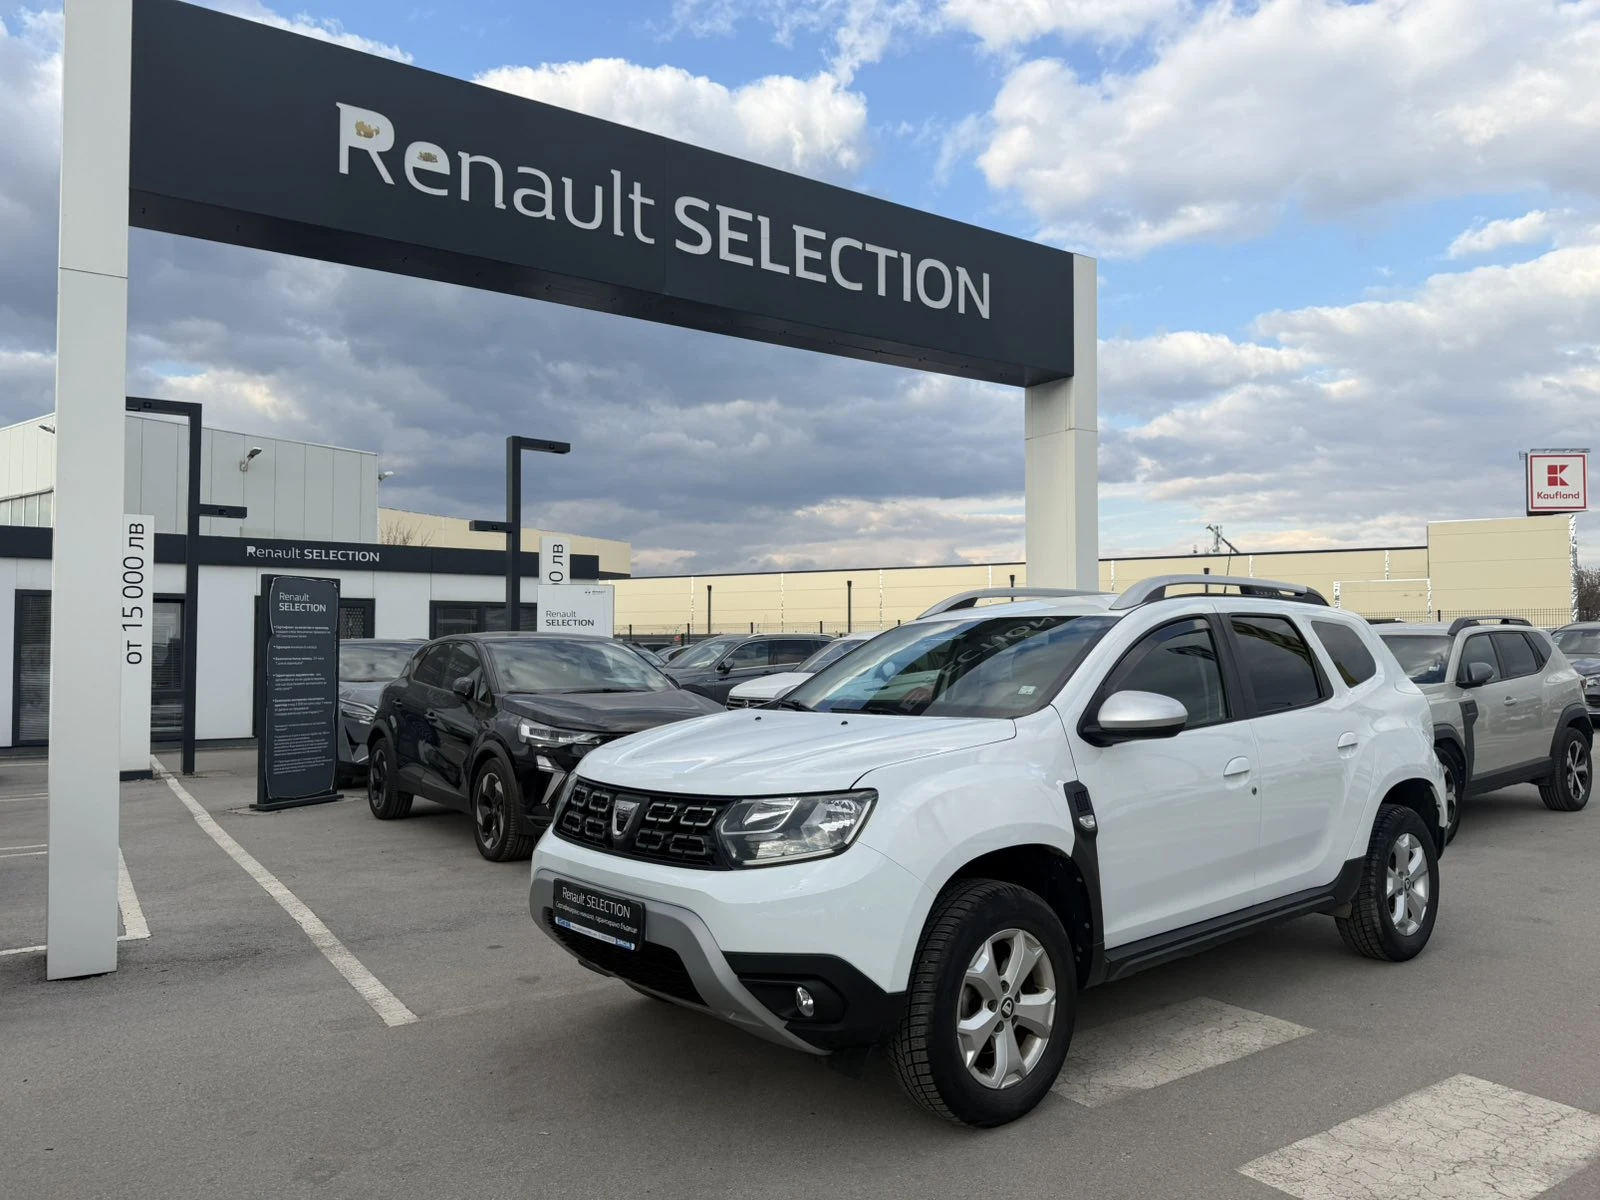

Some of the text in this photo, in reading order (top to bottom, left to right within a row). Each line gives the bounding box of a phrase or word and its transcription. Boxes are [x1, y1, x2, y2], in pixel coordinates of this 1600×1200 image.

[335, 101, 992, 320] Renault SELECTION
[1537, 491, 1580, 500] Kaufland
[246, 545, 380, 562] Renault SELECTION
[122, 556, 144, 599] 000
[279, 592, 310, 602] Renault
[279, 602, 327, 613] SELECTION
[545, 610, 577, 618] Renault
[122, 606, 143, 631] 15
[545, 619, 595, 627] SELECTION
[562, 886, 631, 919] Renault SELECTION
